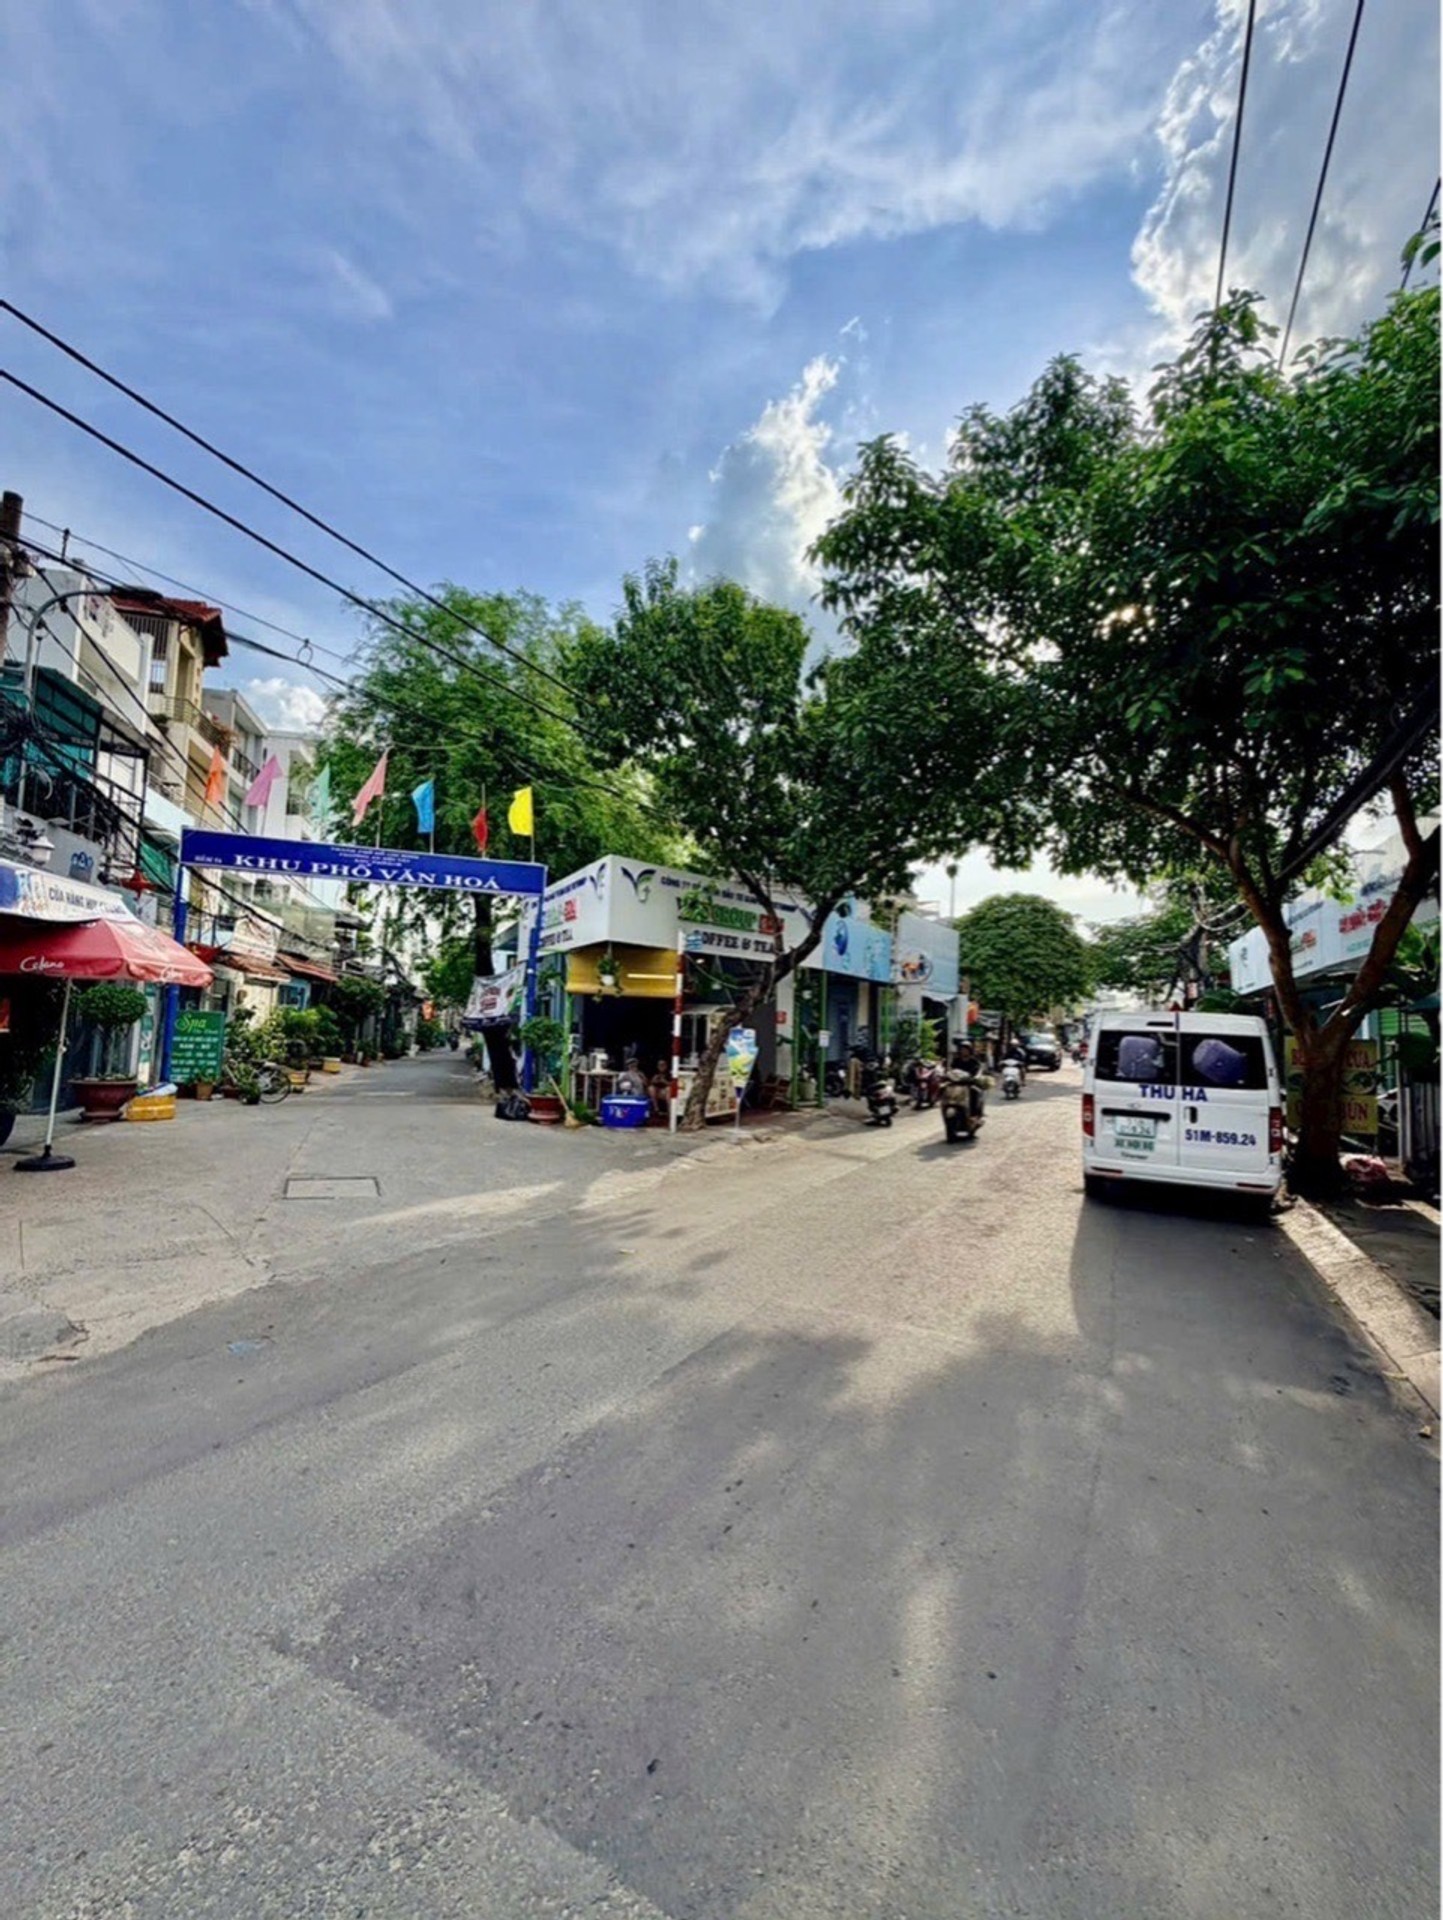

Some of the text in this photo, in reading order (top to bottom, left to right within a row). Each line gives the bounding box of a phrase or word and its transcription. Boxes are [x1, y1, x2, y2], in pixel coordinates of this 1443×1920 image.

[234, 854, 301, 872] KHU
[310, 861, 373, 878] PHỐ
[444, 874, 501, 889] HOÁ
[175, 1012, 207, 1033] Spa
[1139, 1084, 1176, 1100] THU
[1185, 1128, 1257, 1147] 51M-859.24
